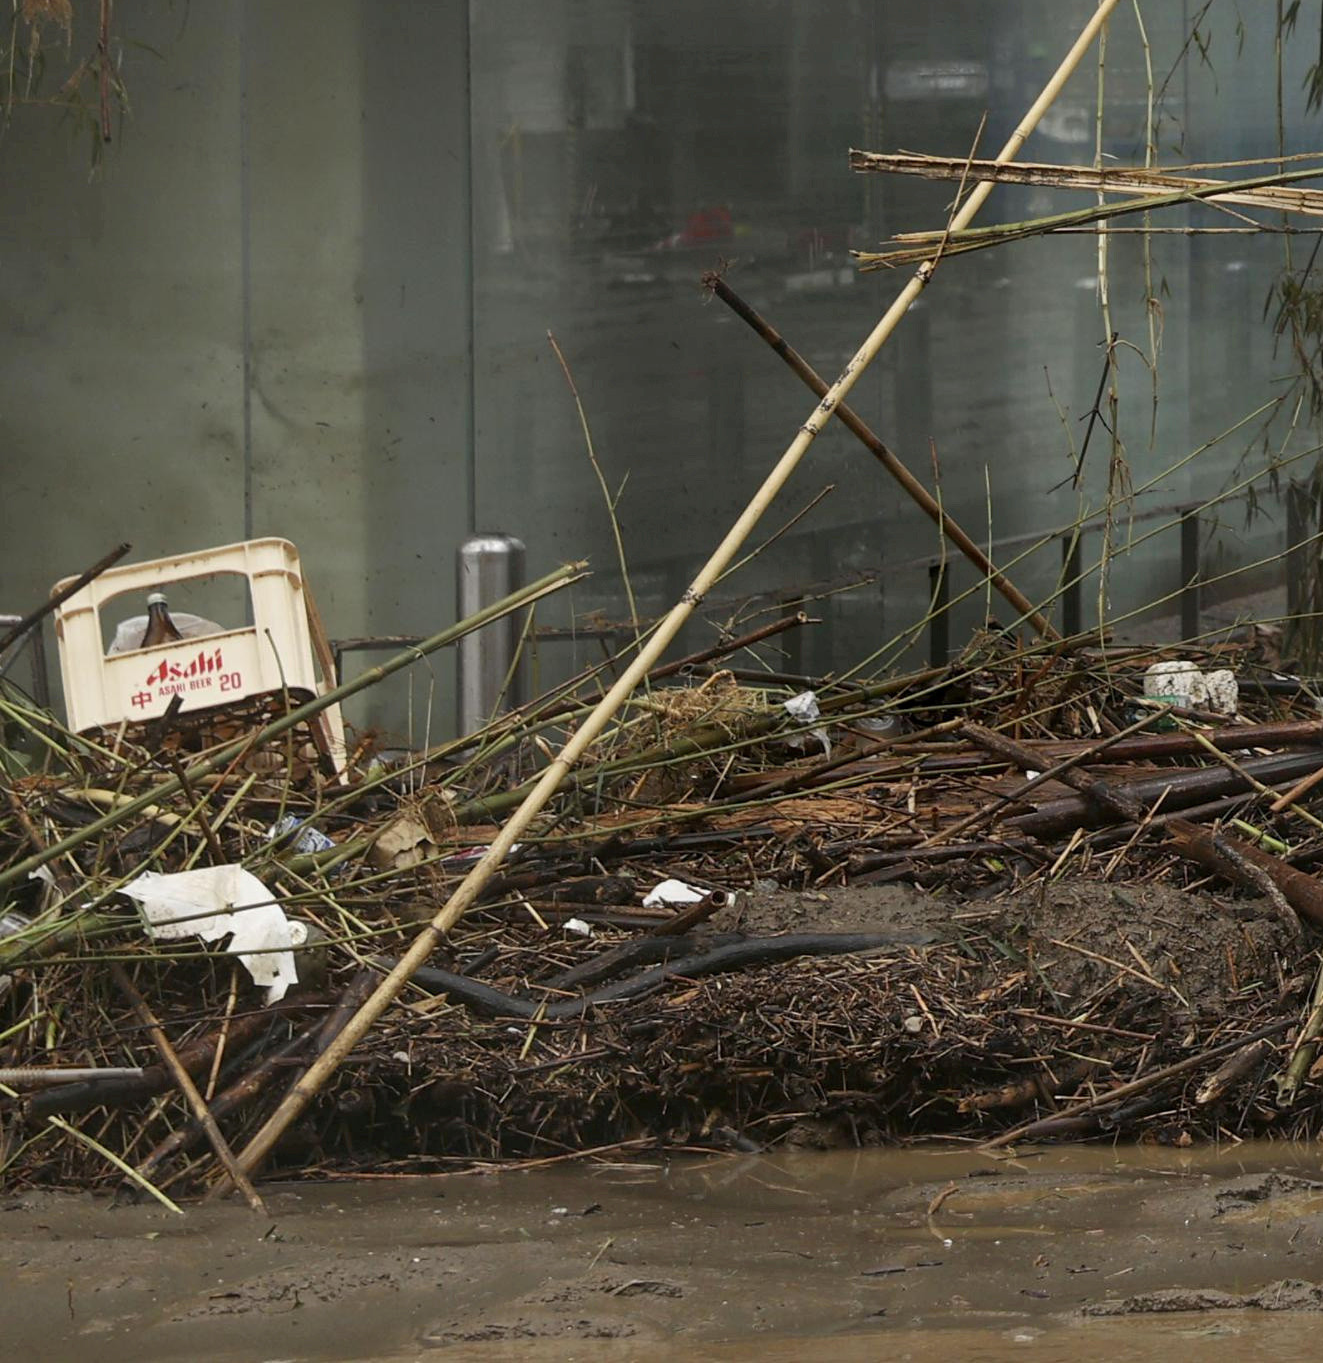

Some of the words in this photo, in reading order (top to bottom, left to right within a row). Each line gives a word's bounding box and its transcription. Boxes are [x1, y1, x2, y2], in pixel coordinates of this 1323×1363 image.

[146, 647, 223, 686] Asahi
[158, 683, 186, 697] ASAHI
[190, 676, 212, 691] BEER
[219, 672, 242, 692] 20
[131, 690, 152, 709] 中
